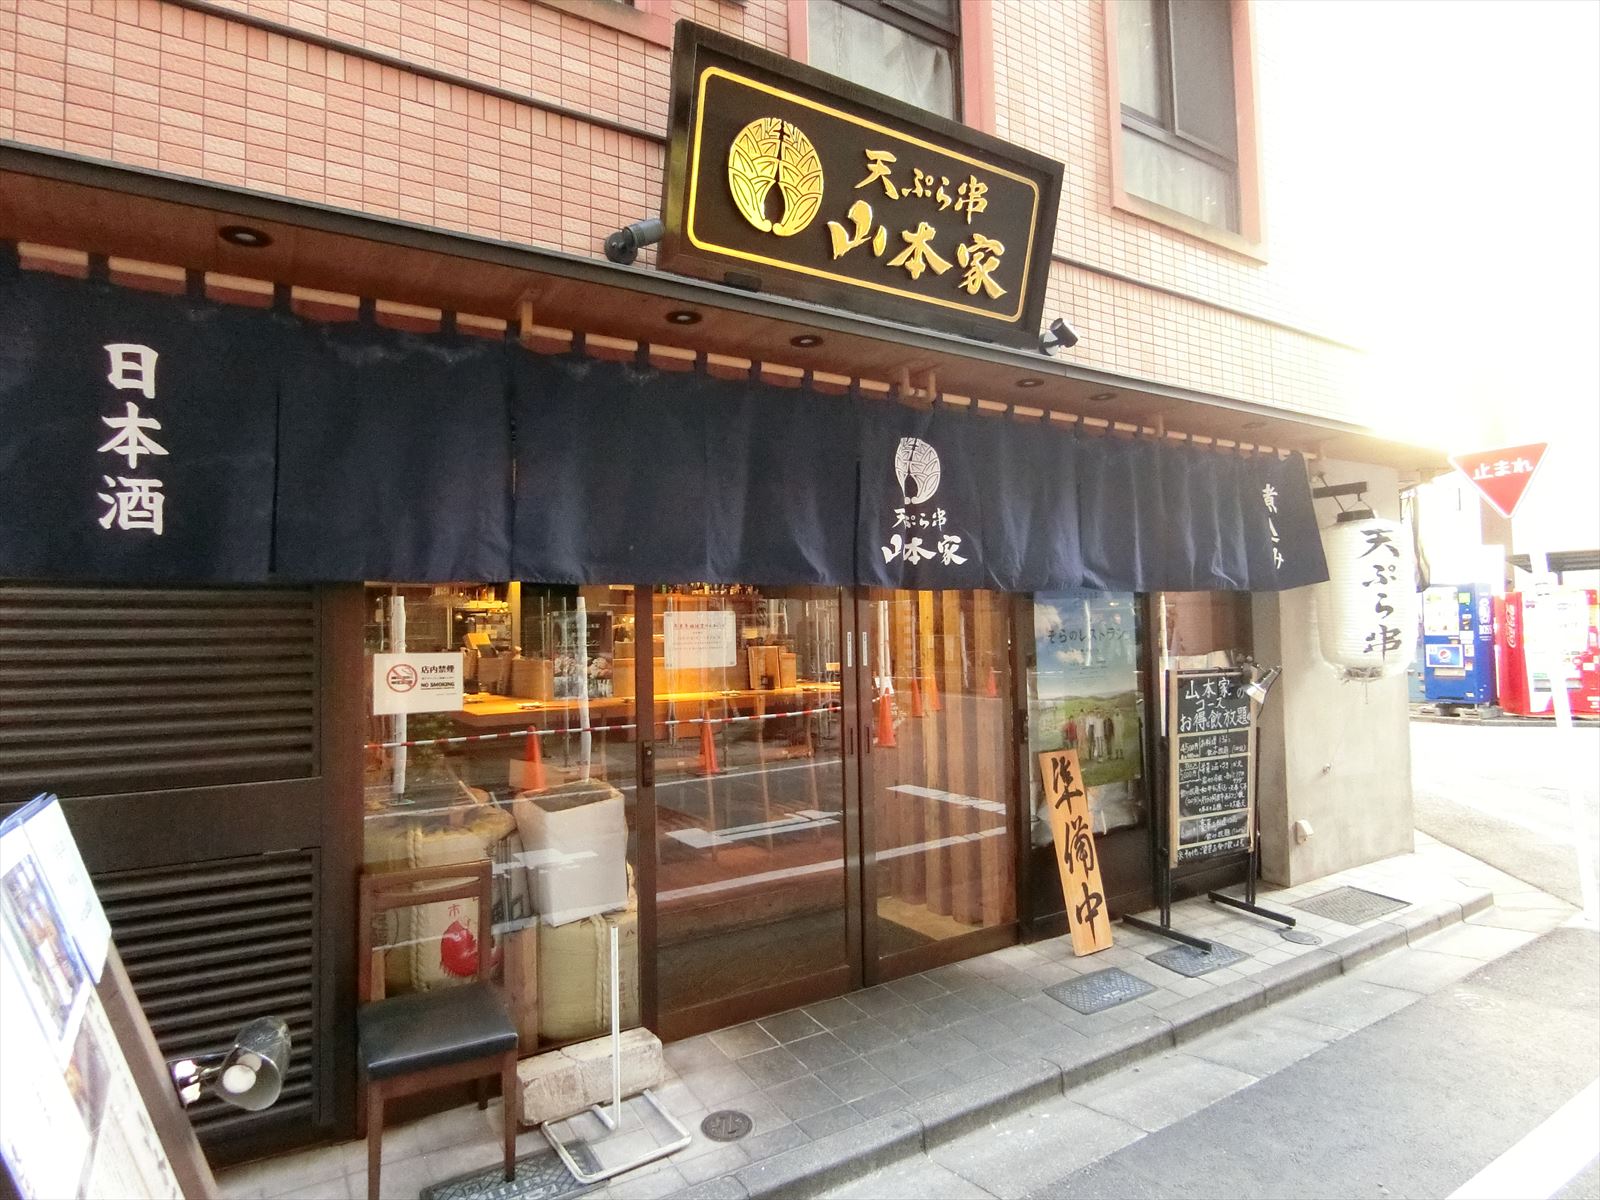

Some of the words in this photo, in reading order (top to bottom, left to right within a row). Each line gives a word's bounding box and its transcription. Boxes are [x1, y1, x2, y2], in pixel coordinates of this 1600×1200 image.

[854, 149, 988, 224] 天ぷら串
[827, 200, 1007, 299] 山本家
[97, 343, 170, 535] 日本酒
[1473, 457, 1534, 480] 止まれ
[881, 534, 968, 566] 山本家
[1358, 528, 1402, 661] 天ぷら串
[421, 665, 455, 674] 店内禁煙
[1195, 697, 1226, 712] コース
[1051, 756, 1103, 946] 準備中
